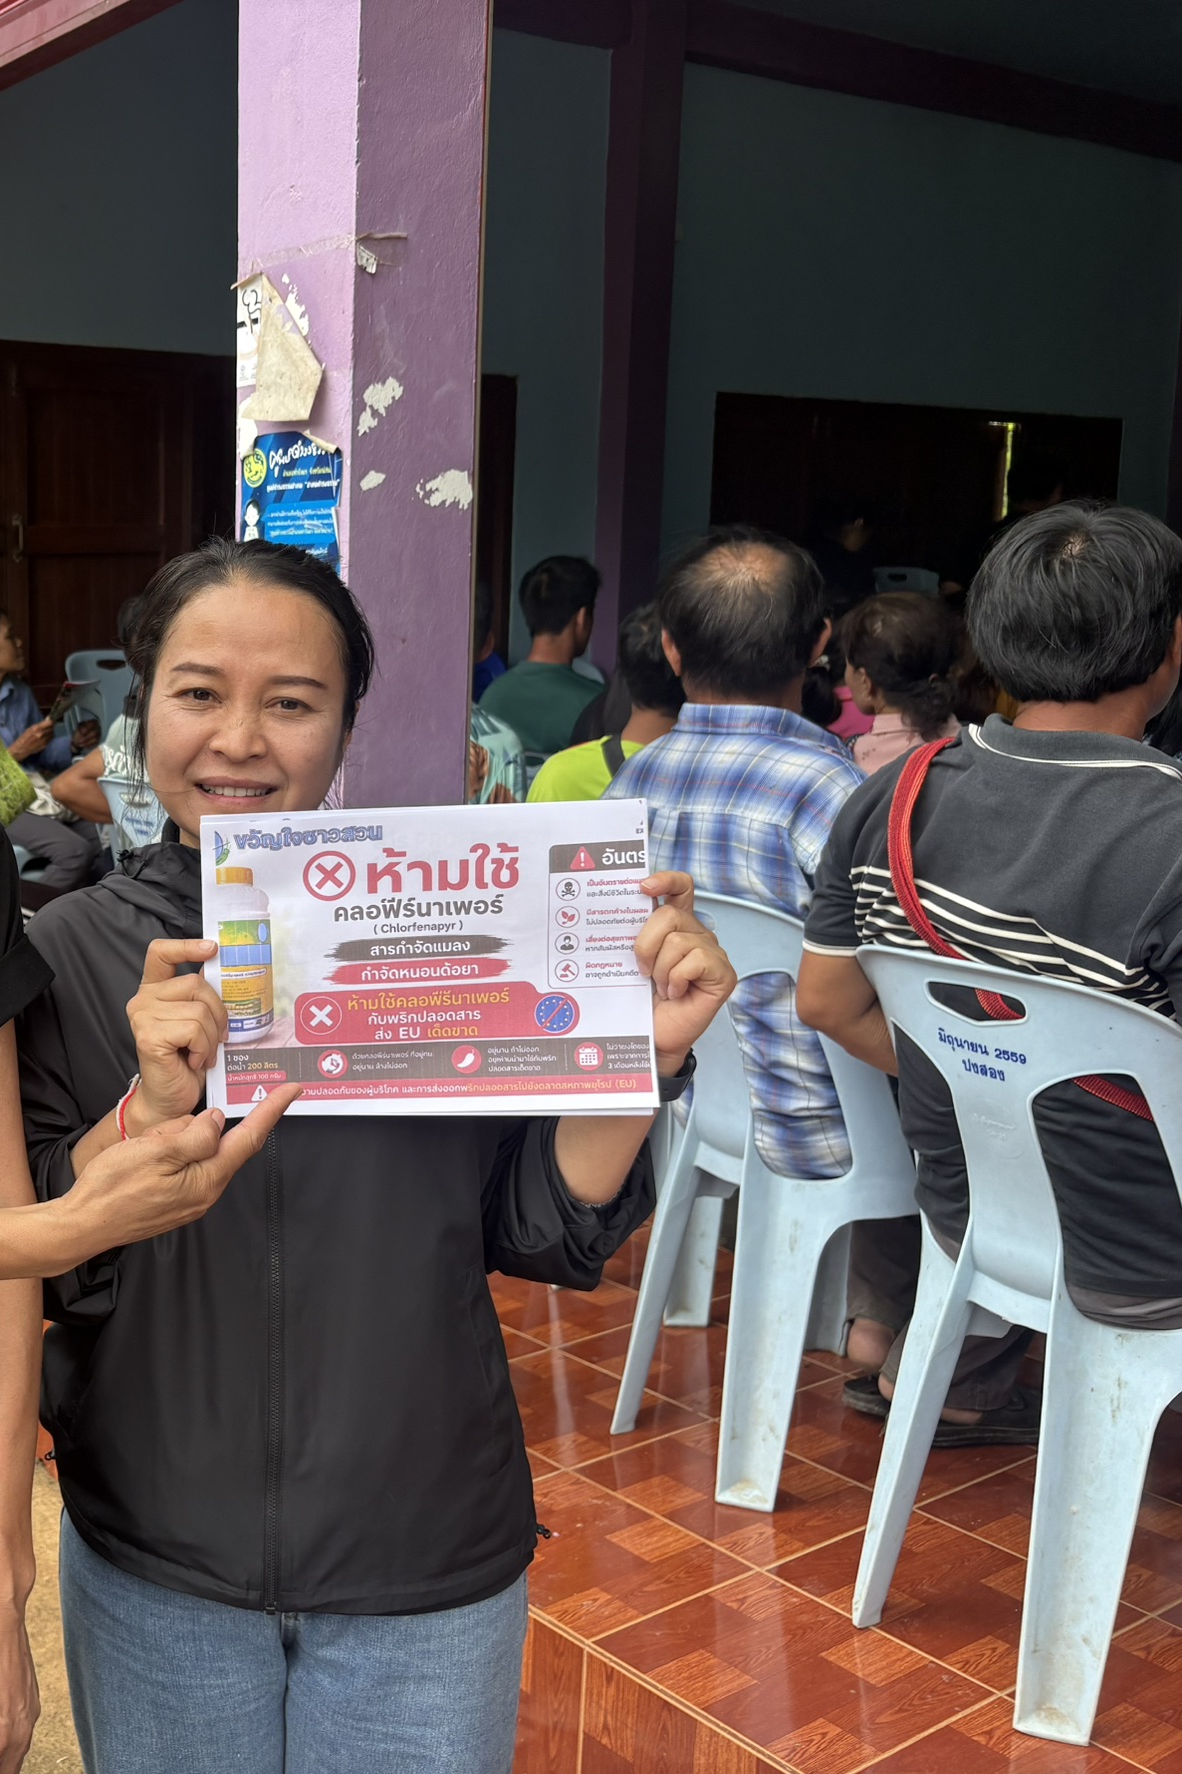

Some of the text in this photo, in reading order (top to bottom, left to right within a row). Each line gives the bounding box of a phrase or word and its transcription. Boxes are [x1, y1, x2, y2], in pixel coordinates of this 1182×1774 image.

[233, 825, 383, 851] ขวัญใจชาวสวน
[367, 843, 519, 894] ห้ามใช้
[380, 922, 457, 934] Chlorfenapyr
[370, 940, 471, 956] สารกำจัดแมลง
[368, 1009, 481, 1026] กับพริกปลอดสาร
[374, 1023, 479, 1040] ส่ง EU เด็ดขาด
[938, 1027, 1027, 1065] มิถุนายน 2559
[247, 1062, 263, 1070] 200
